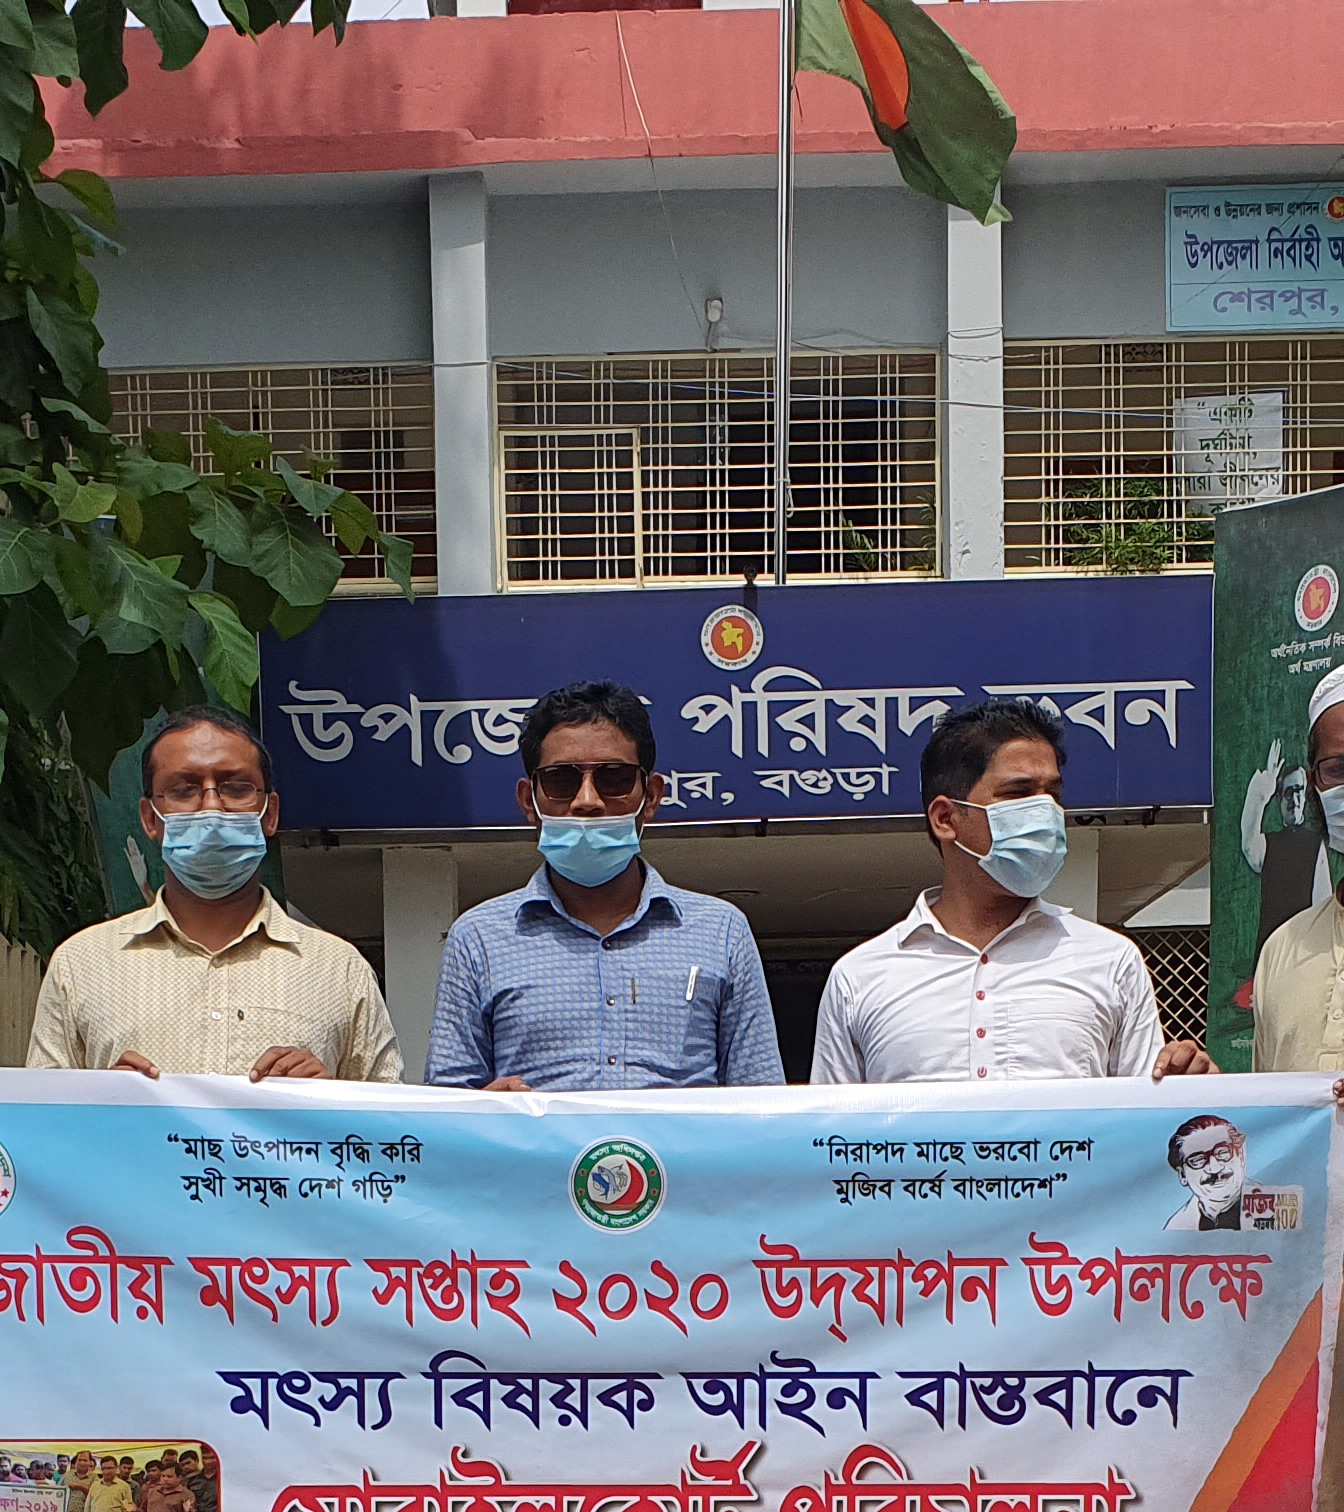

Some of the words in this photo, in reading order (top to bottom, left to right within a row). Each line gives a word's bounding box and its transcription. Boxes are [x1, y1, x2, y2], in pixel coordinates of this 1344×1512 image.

[1183, 233, 1259, 272] উপজেলা
[1266, 224, 1322, 272] নির্বাহী
[1213, 287, 1340, 317] শেরপুর,
[754, 763, 900, 804] বগুড়া
[166, 1134, 224, 1163] “মাছ
[231, 1133, 320, 1164] উৎপাদন
[328, 1134, 371, 1164] বৃদ্ধি
[379, 1137, 422, 1164] করি
[812, 1134, 905, 1166] “নিরাপদ
[913, 1140, 965, 1165] মাছে
[973, 1140, 1040, 1164] ভরবো
[1049, 1137, 1094, 1163] দেশ
[181, 1168, 226, 1203] সুখী
[234, 1172, 288, 1208] সমৃদ্ধ
[297, 1174, 342, 1200] দেশ
[351, 1173, 406, 1205] গড়ি”
[832, 1173, 892, 1204] মুজিব
[901, 1169, 945, 1202] বর্ষে
[953, 1172, 1067, 1202] বাংলাদেশ”
[188, 1257, 350, 1326] মৎস্য
[362, 1248, 531, 1338] সপ্তাহ
[553, 1259, 729, 1337] ২০২০
[1022, 1232, 1272, 1322] উপলক্ষে
[217, 1370, 405, 1432] মৎস্য
[421, 1350, 662, 1432] বিষয়ক
[684, 1350, 880, 1434] আইন
